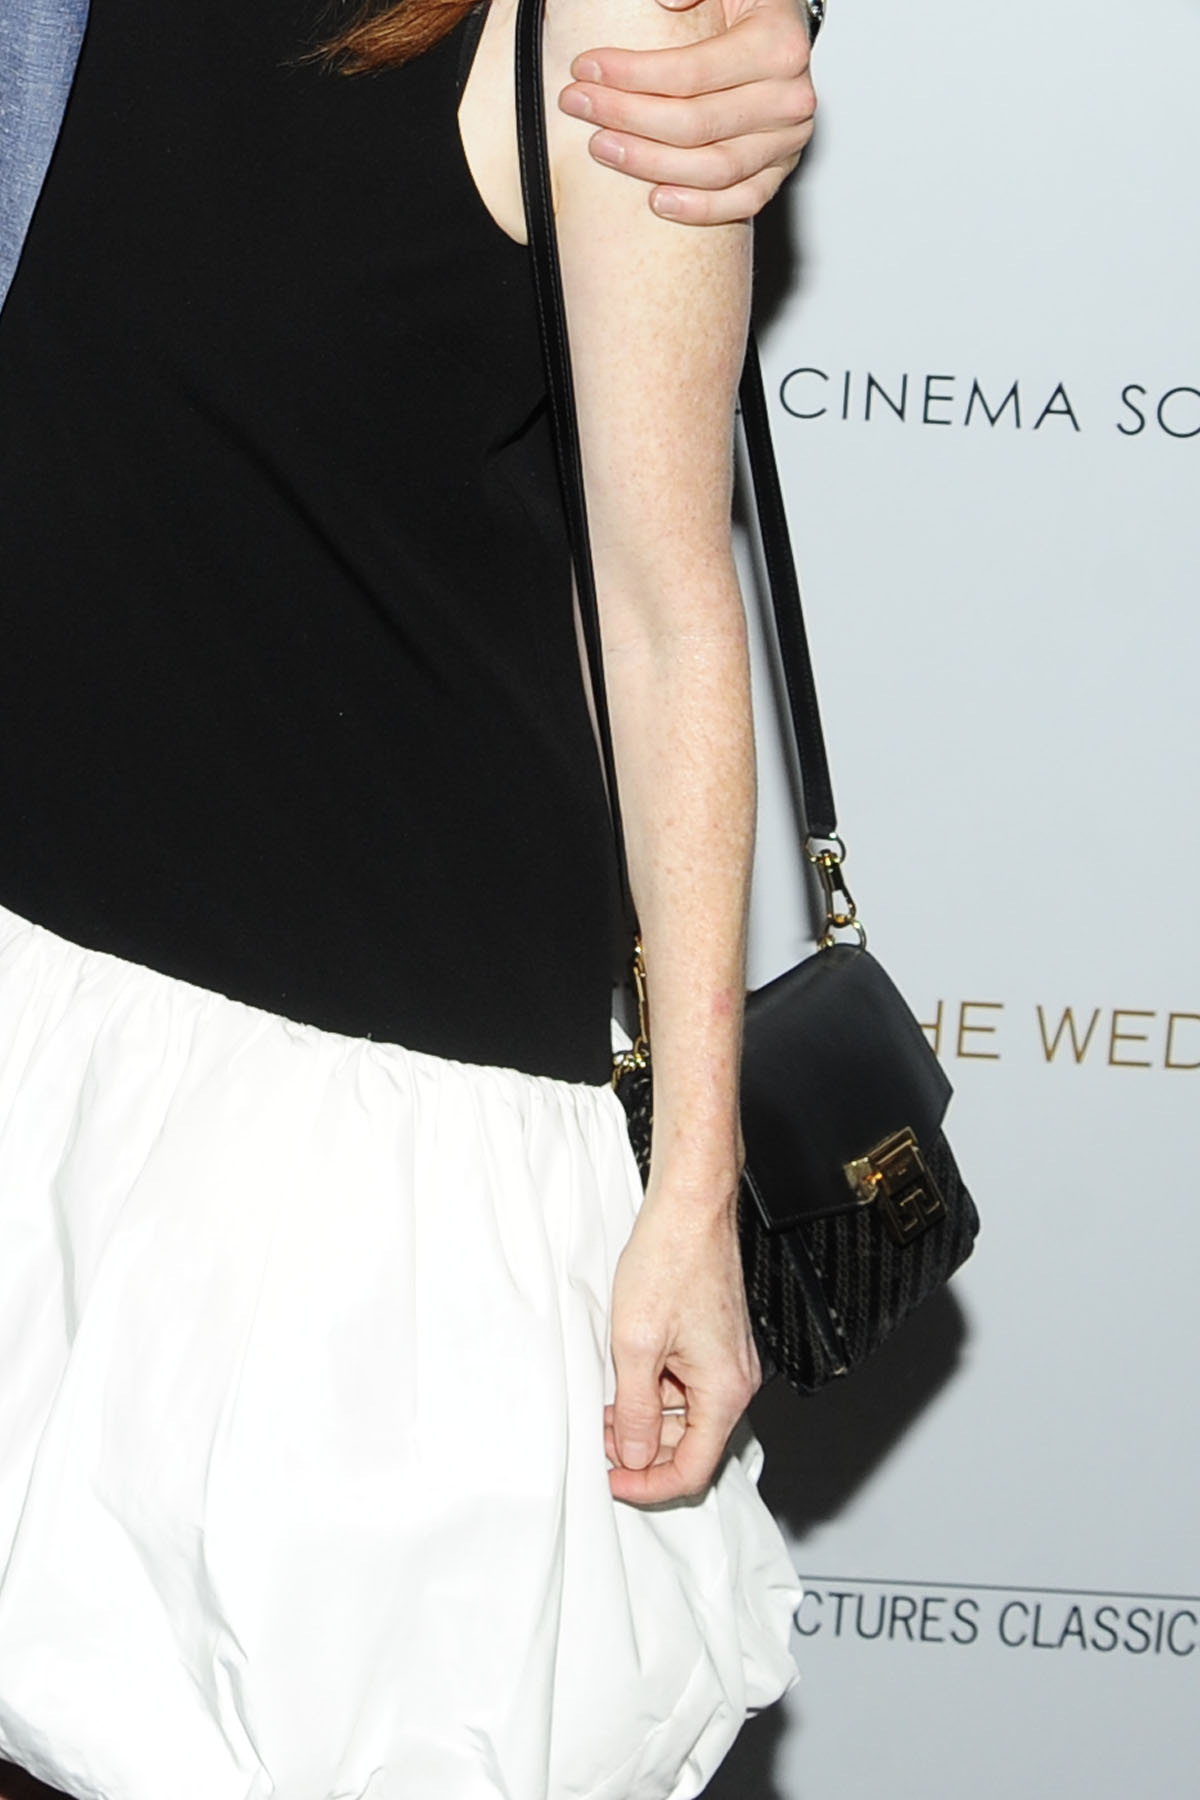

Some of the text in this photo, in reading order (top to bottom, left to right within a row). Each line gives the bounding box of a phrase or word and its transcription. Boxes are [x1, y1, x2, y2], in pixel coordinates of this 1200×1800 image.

[779, 368, 1200, 438] CINEMA SO
[1036, 1005, 1200, 1070] WED
[999, 1601, 1198, 1656] CLASSIC
